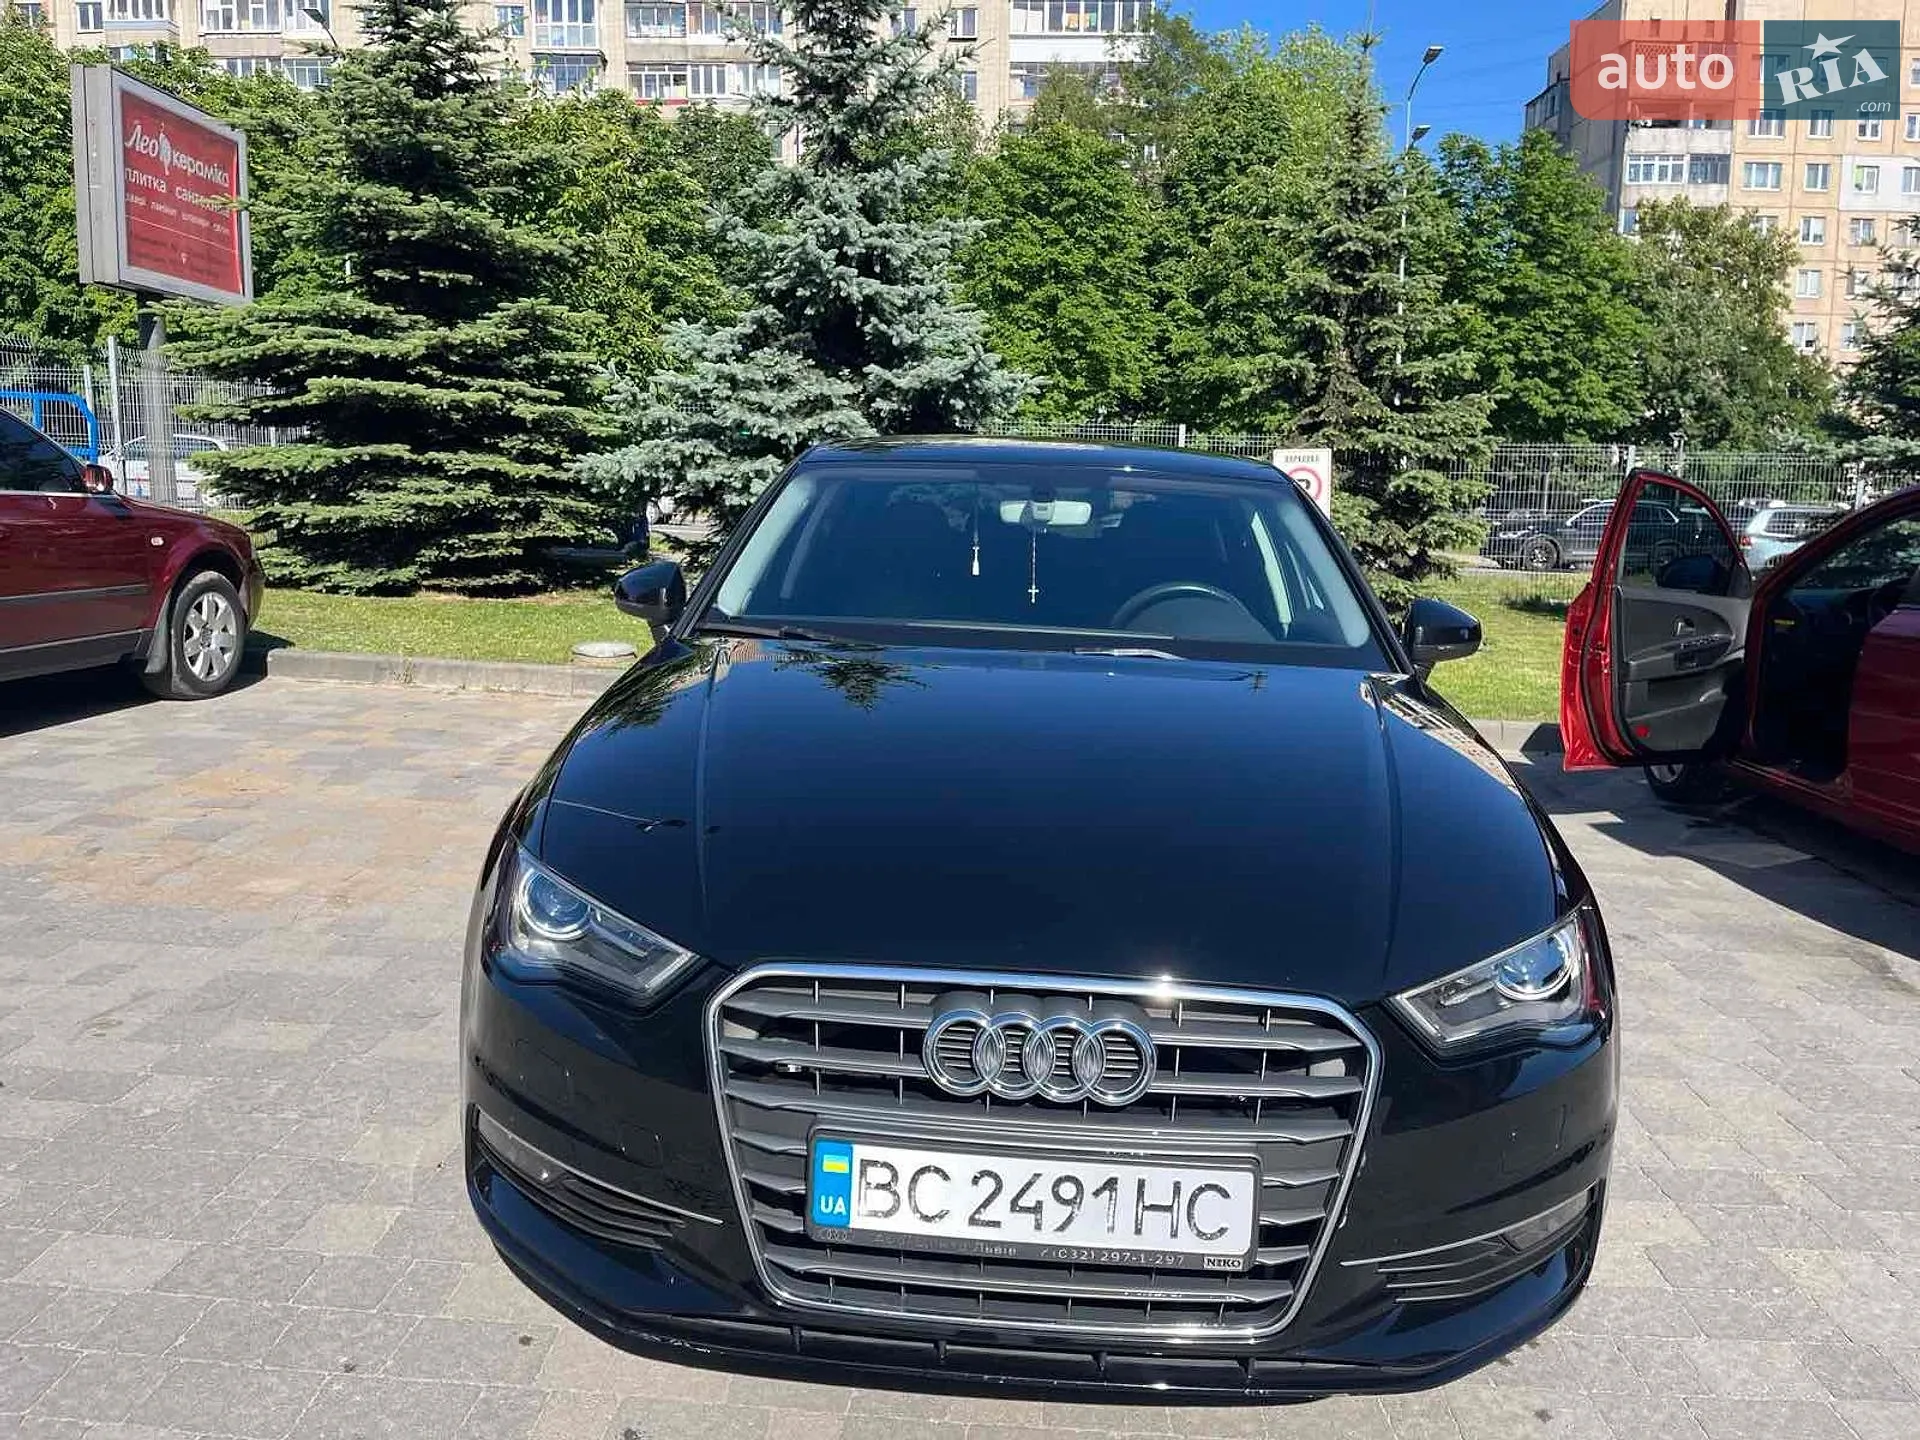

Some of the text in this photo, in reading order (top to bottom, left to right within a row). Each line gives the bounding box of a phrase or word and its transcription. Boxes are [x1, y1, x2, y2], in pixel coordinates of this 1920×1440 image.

[124, 124, 159, 157] Лео
[125, 167, 167, 193] плитка
[820, 1195, 847, 1216] UA
[858, 1158, 951, 1222] BC
[967, 1169, 1118, 1235] 2491
[1206, 1258, 1241, 1269] NIKO
